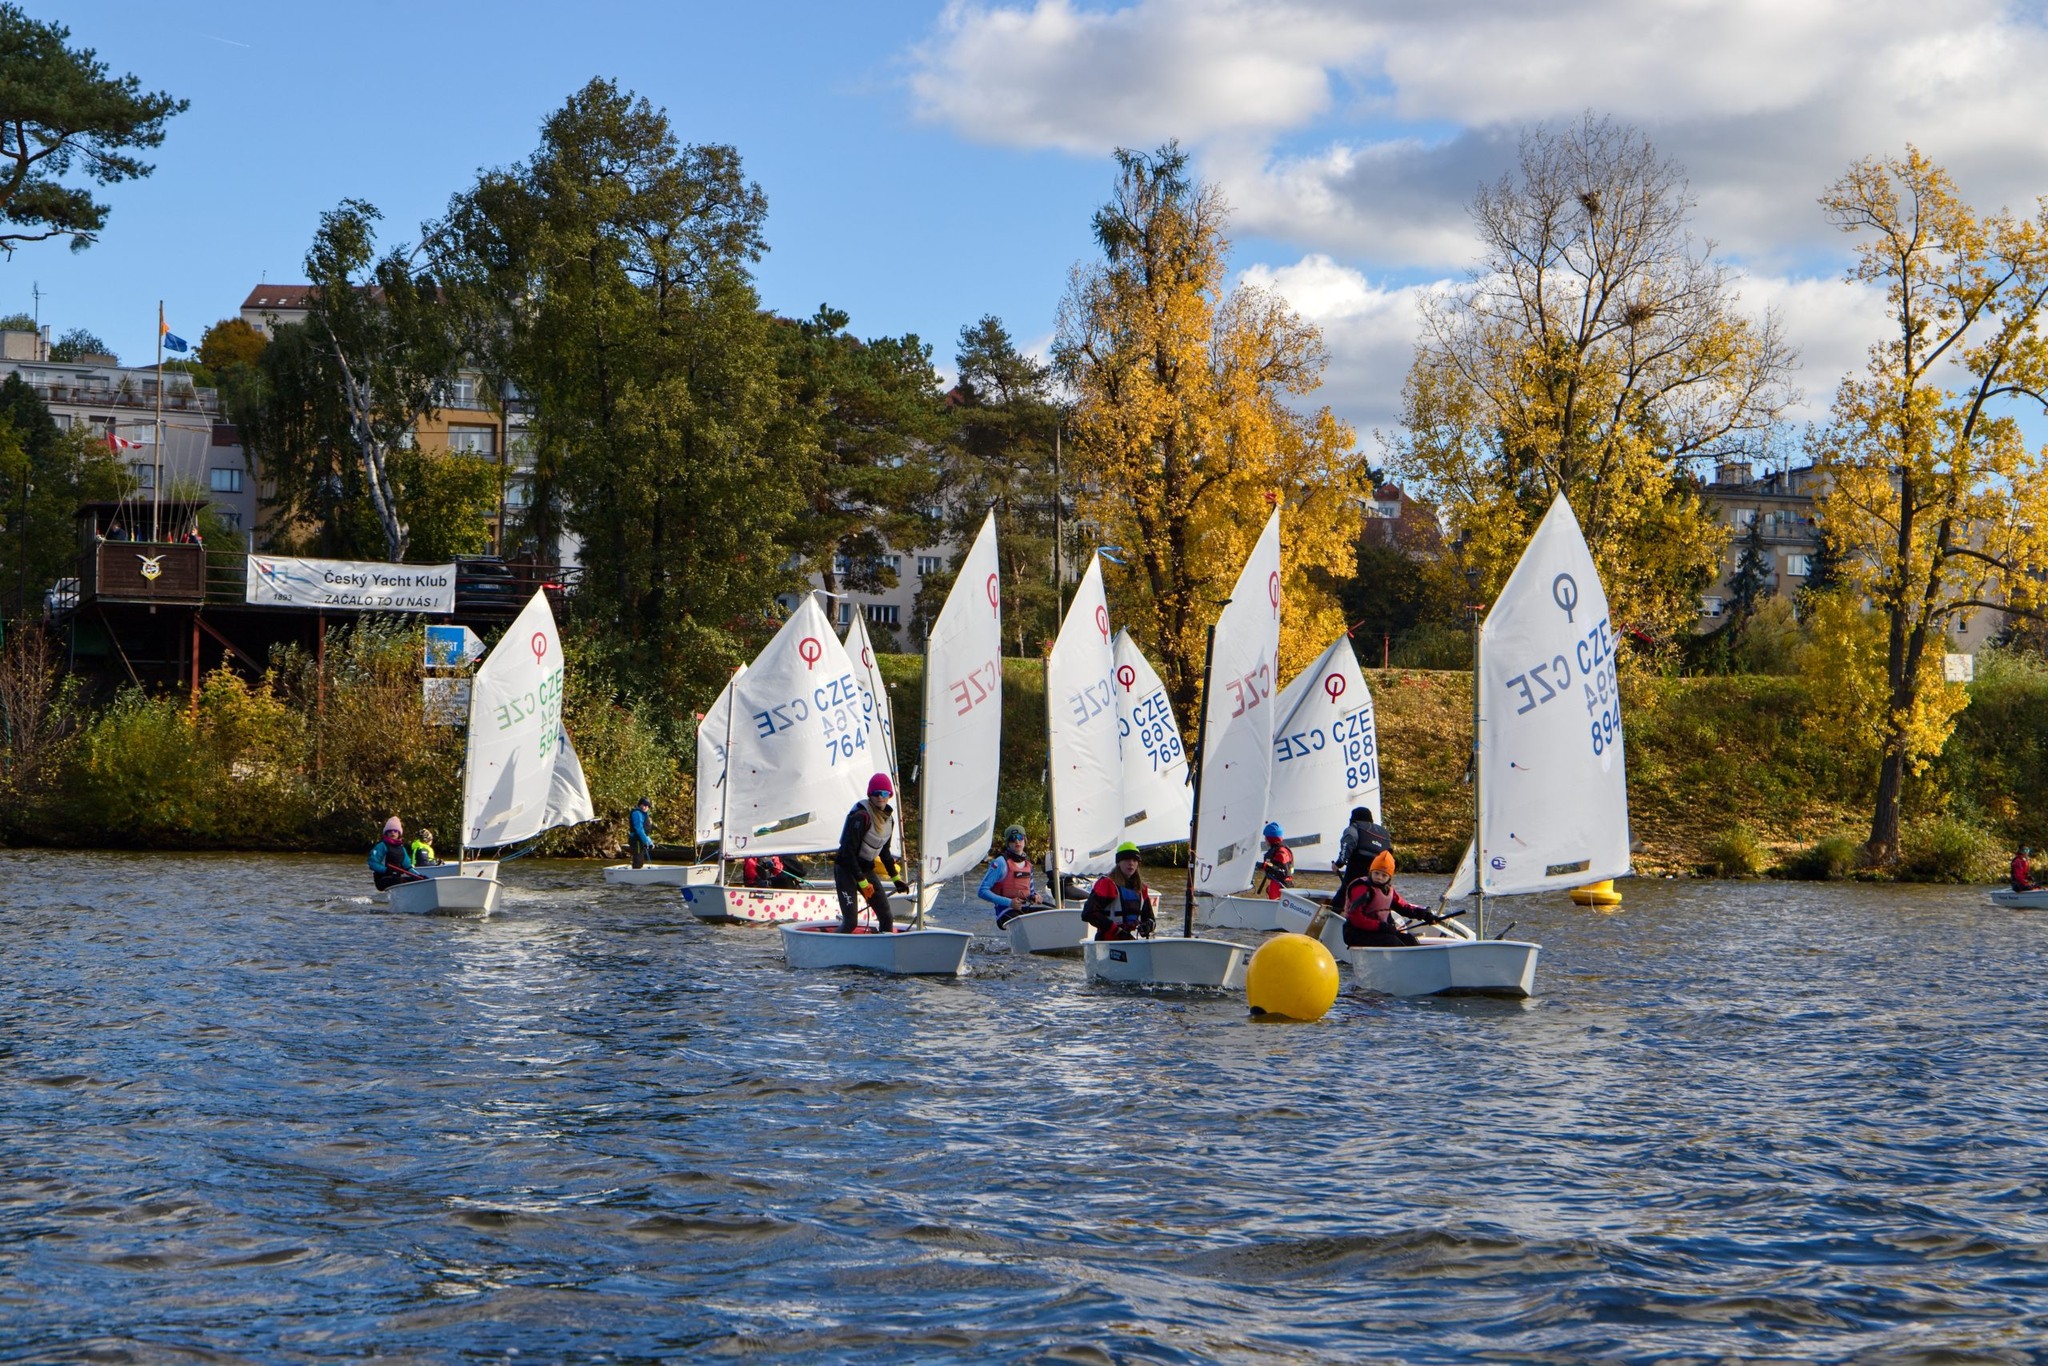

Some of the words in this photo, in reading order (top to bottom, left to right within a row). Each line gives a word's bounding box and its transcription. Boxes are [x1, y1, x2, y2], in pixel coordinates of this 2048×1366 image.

[273, 593, 292, 601] 1893
[324, 570, 367, 588] Český
[372, 574, 411, 587] Yacht
[415, 575, 447, 587] Klub
[377, 596, 393, 606] TO
[395, 596, 406, 606] U
[1576, 618, 1612, 675] CZE
[539, 668, 562, 706] CZE
[814, 673, 857, 711] CZE
[1133, 691, 1168, 727] CZE
[1332, 708, 1372, 743] CZE
[1591, 699, 1620, 756] 894
[826, 728, 865, 767] 764
[1148, 736, 1181, 772] 769
[1346, 758, 1376, 789] 891
